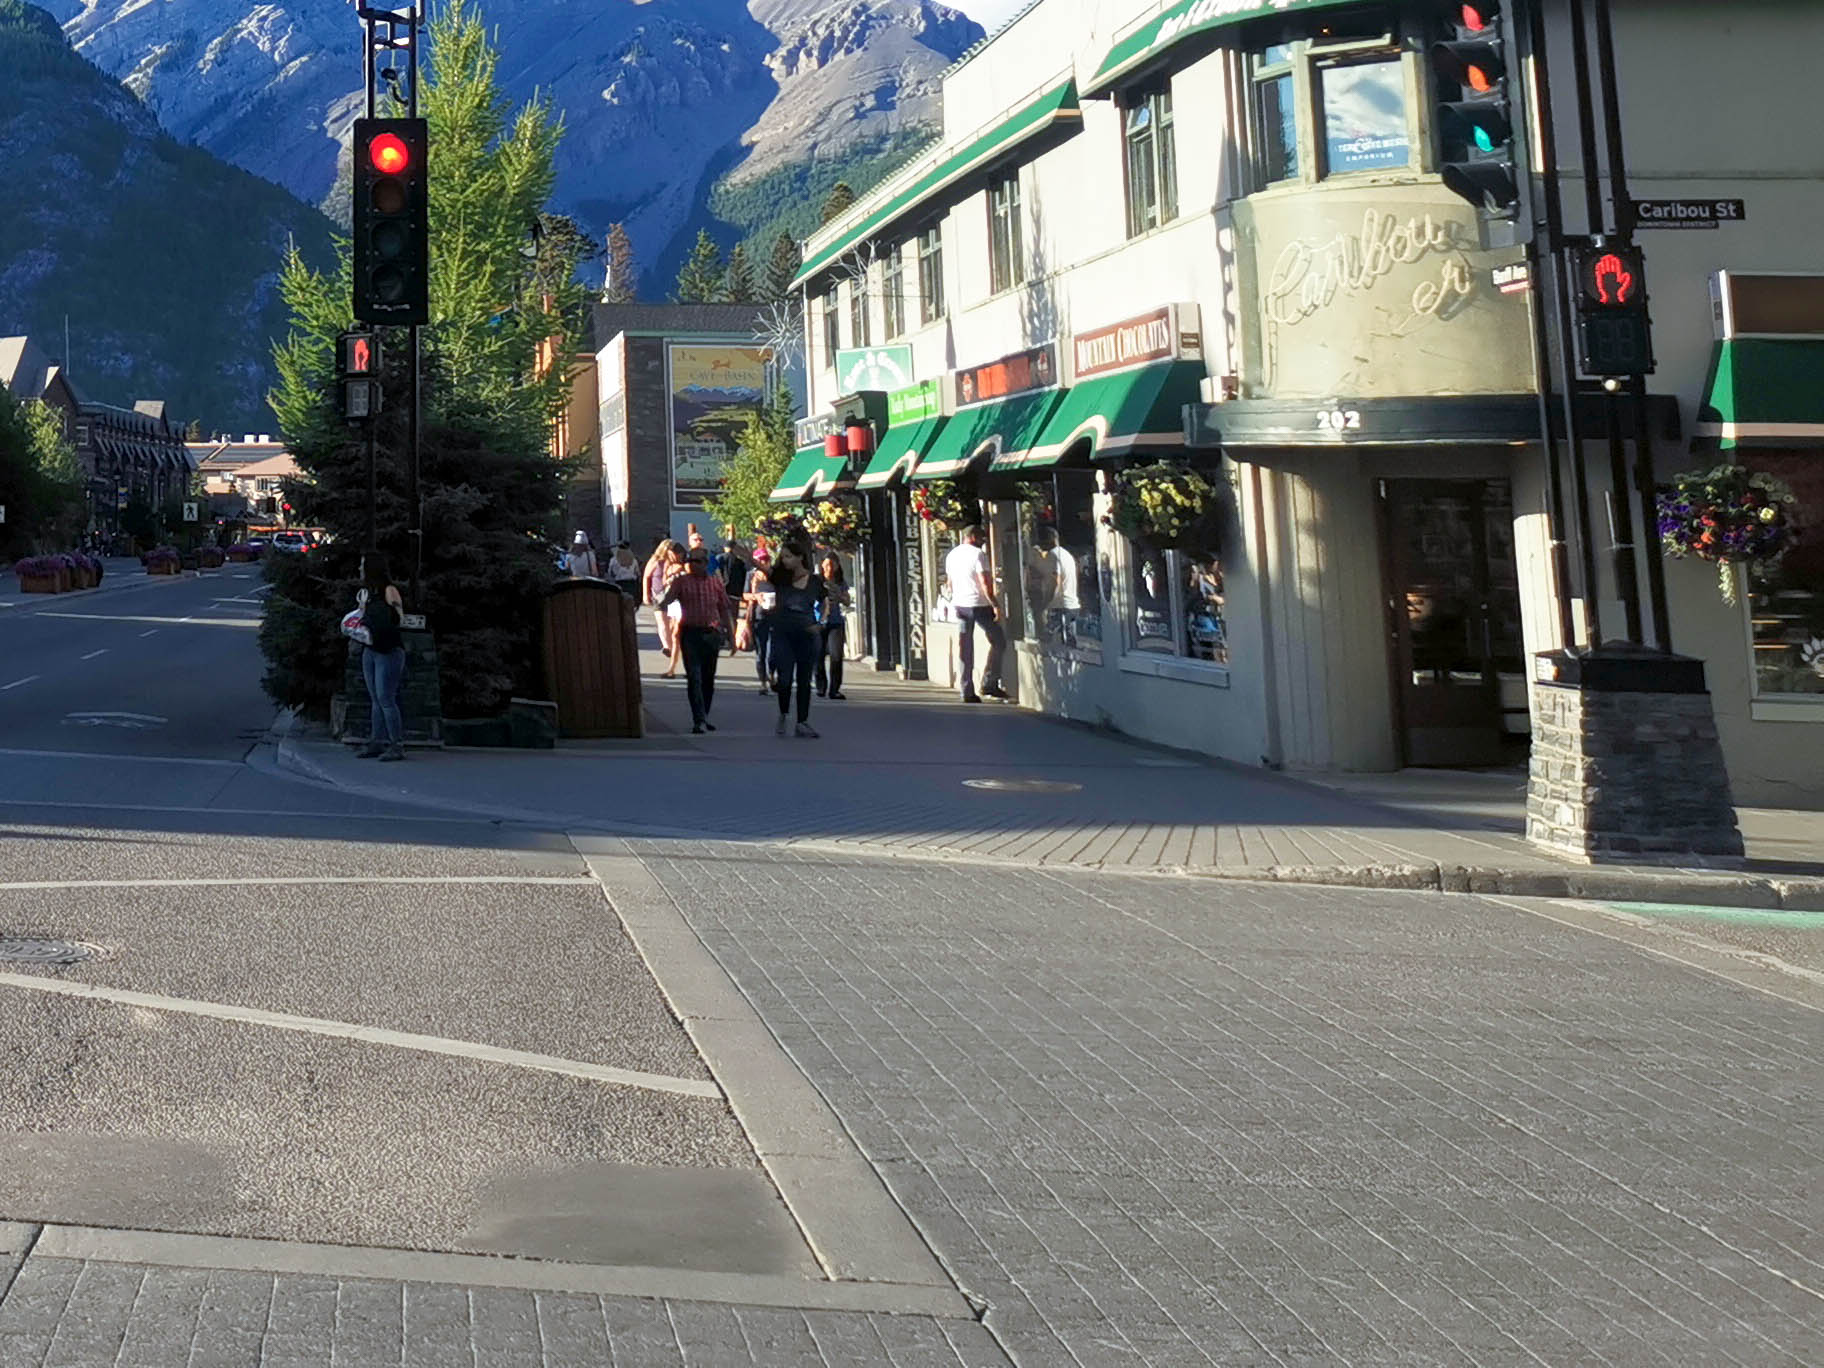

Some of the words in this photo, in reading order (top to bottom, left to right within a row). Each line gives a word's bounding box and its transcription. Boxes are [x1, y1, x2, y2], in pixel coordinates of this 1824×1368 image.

[1638, 202, 1711, 218] Caribou
[1715, 201, 1737, 218] St
[1316, 410, 1361, 430] 202
